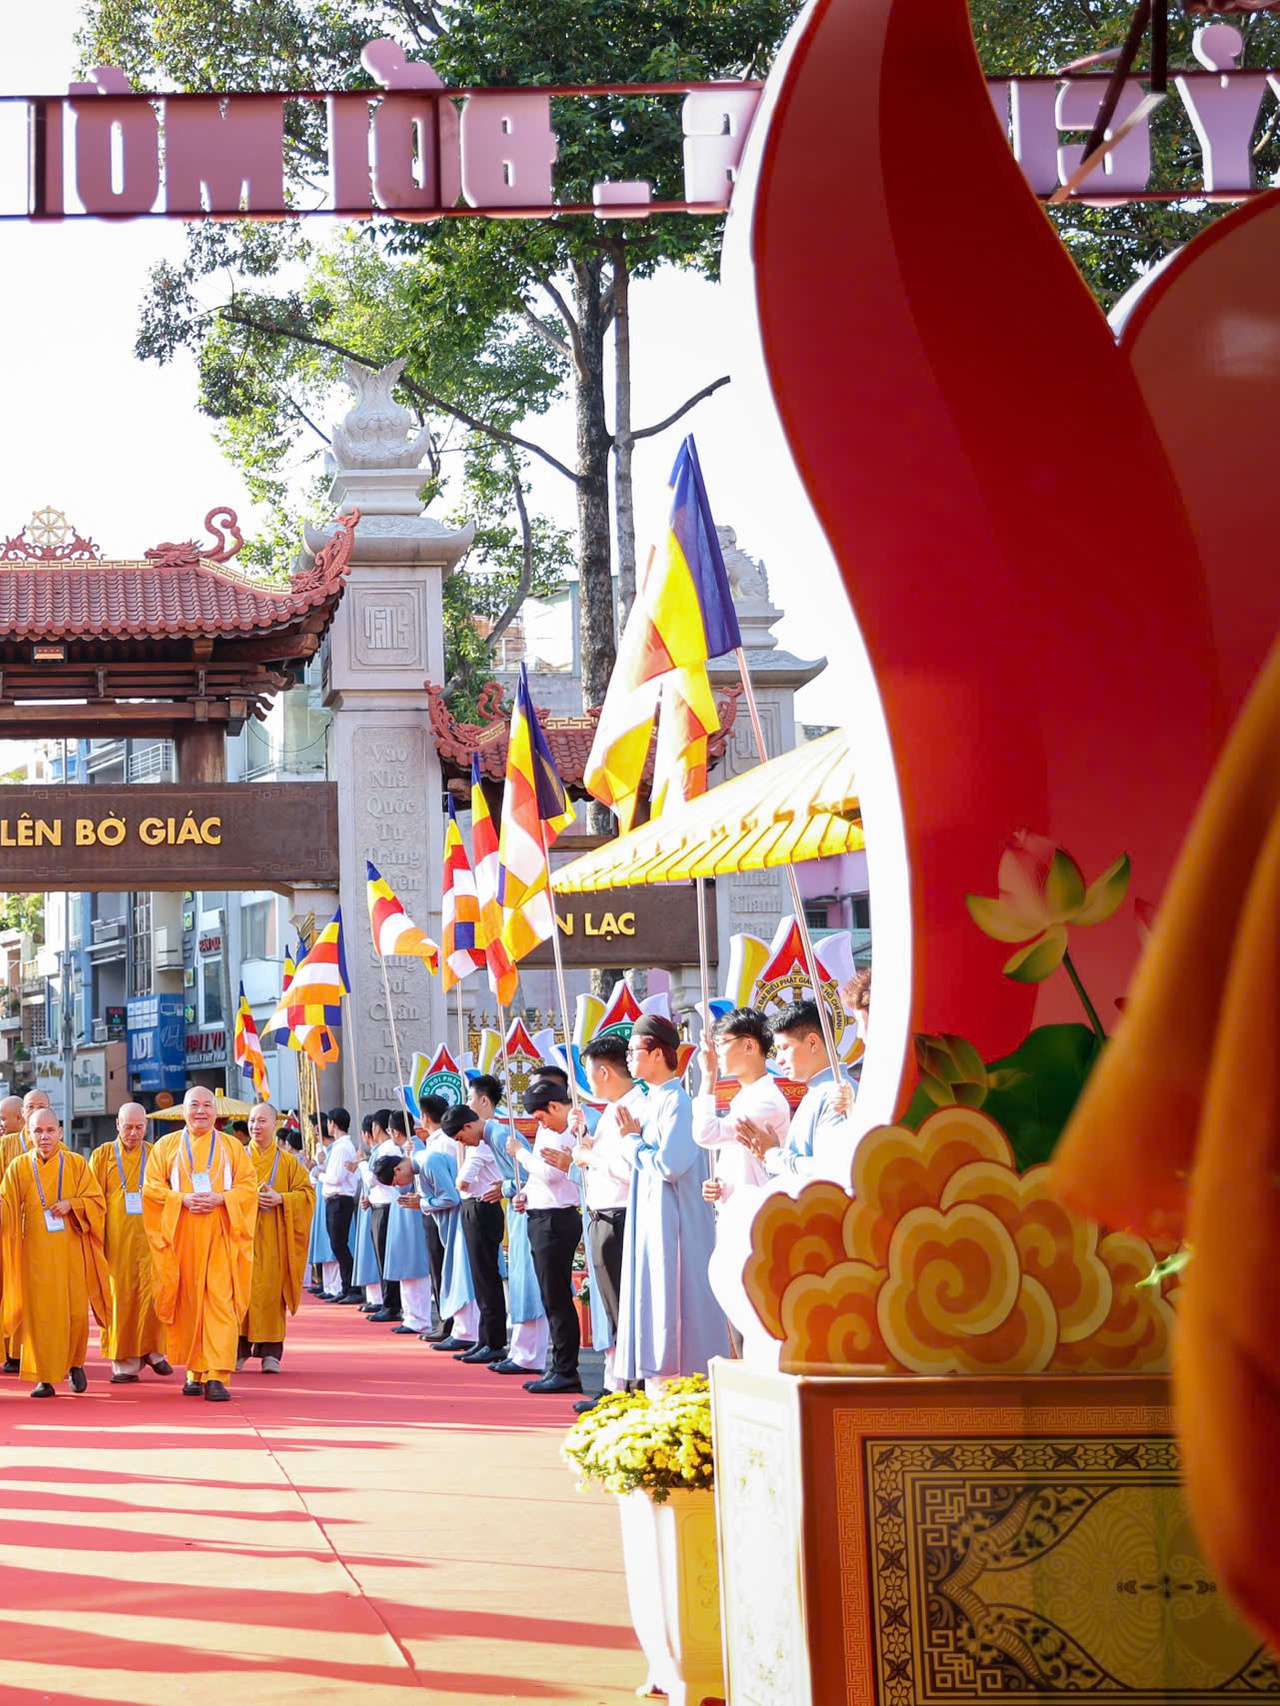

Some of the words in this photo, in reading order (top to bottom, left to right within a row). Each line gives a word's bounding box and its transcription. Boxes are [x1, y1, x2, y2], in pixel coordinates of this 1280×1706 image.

[0, 812, 62, 846] LÊN
[75, 810, 126, 846] BỜ
[138, 809, 221, 846] GIÁC
[584, 911, 636, 941] LẠC
[132, 1031, 154, 1060] NDT
